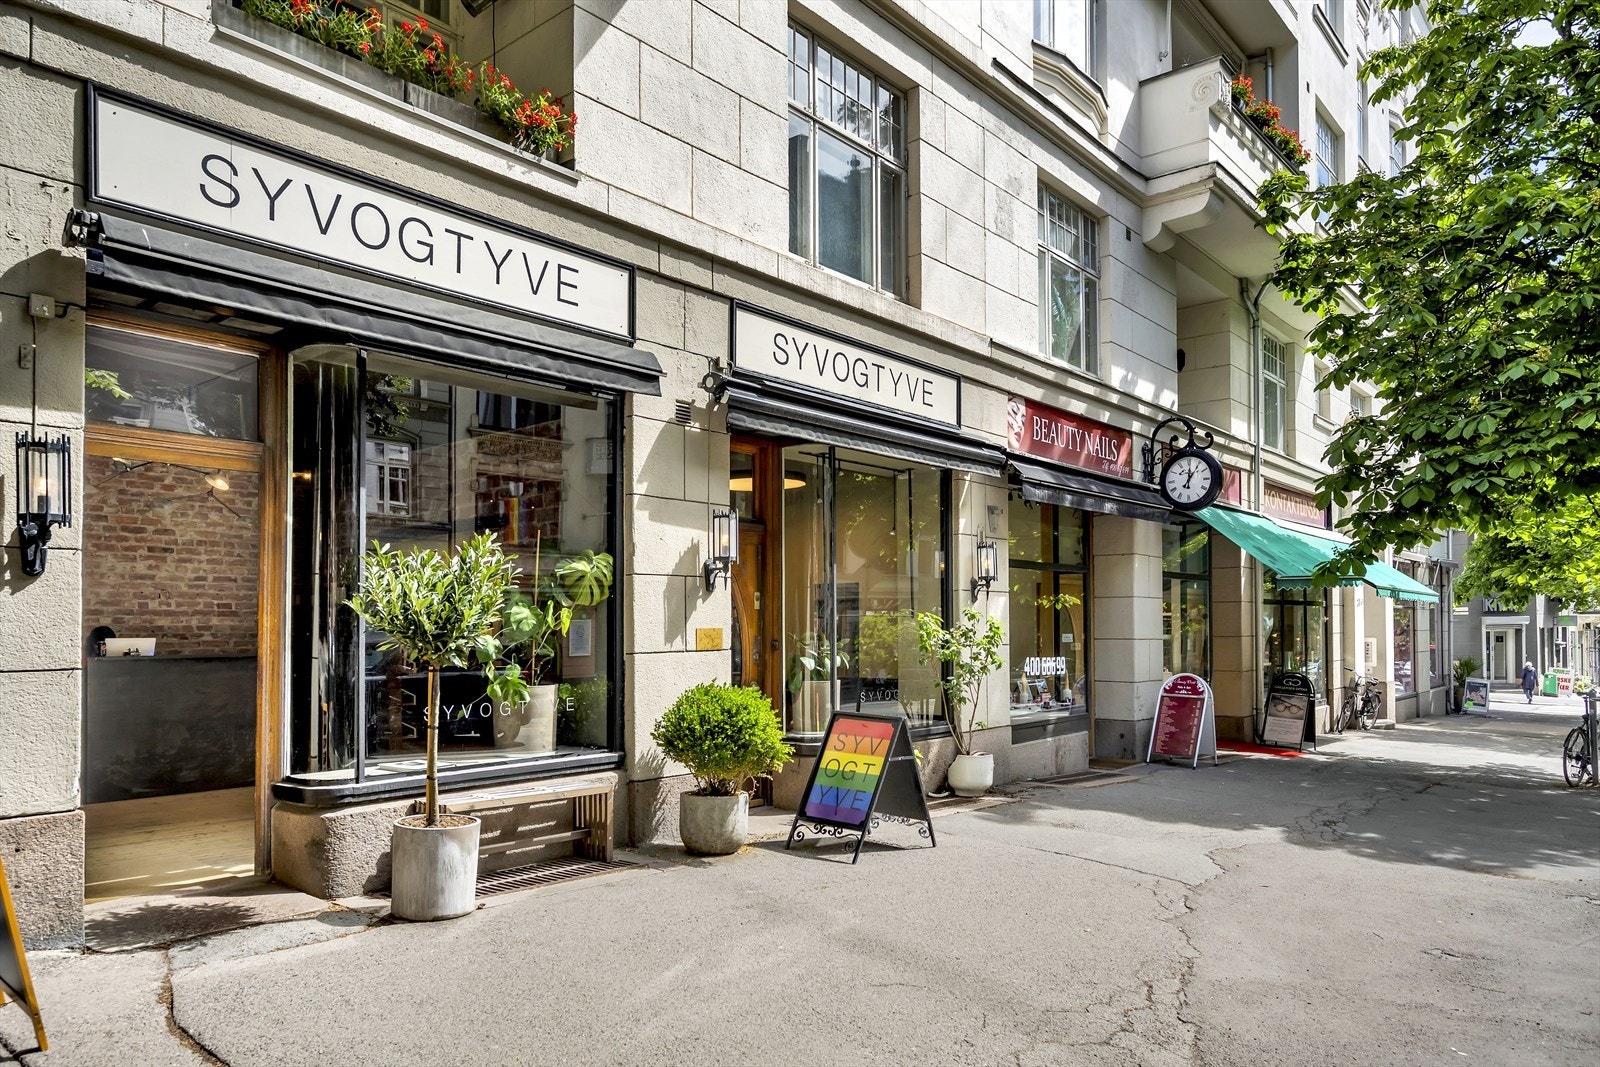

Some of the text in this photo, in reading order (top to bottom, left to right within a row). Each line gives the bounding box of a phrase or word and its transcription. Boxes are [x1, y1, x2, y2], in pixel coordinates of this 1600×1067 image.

[200, 154, 579, 307] SYVOGTYVE
[773, 332, 933, 408] SYVOGTYVE
[1033, 416, 1118, 461] BEAUTY NAILS
[1024, 656, 1041, 676] 400
[833, 732, 885, 756] SYV
[824, 758, 876, 783] OGT
[819, 784, 867, 811] YVE
